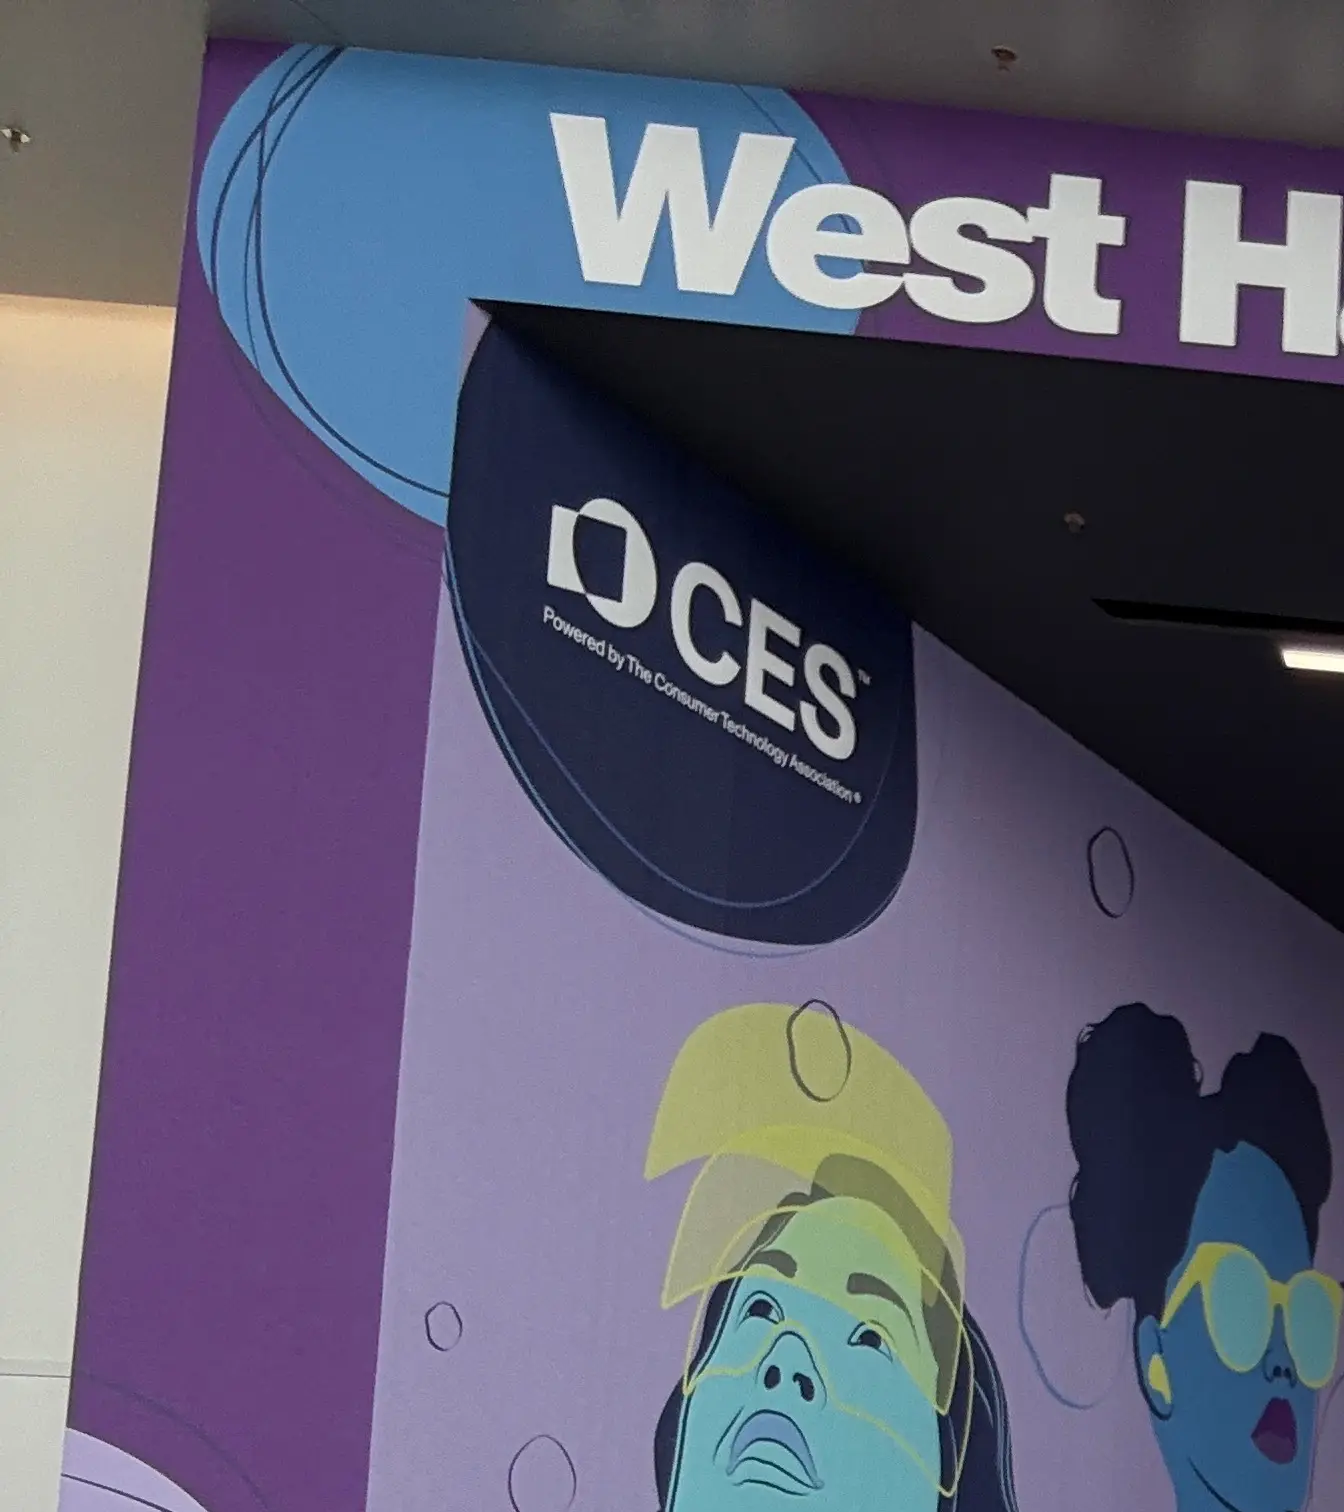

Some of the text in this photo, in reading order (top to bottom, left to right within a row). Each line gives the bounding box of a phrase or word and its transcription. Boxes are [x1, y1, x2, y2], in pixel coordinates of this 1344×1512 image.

[549, 112, 1126, 335] West
[543, 605, 606, 656] Powered
[608, 641, 629, 671] by
[625, 653, 653, 684] The
[654, 672, 722, 723] Consumer
[719, 711, 789, 768] Technology
